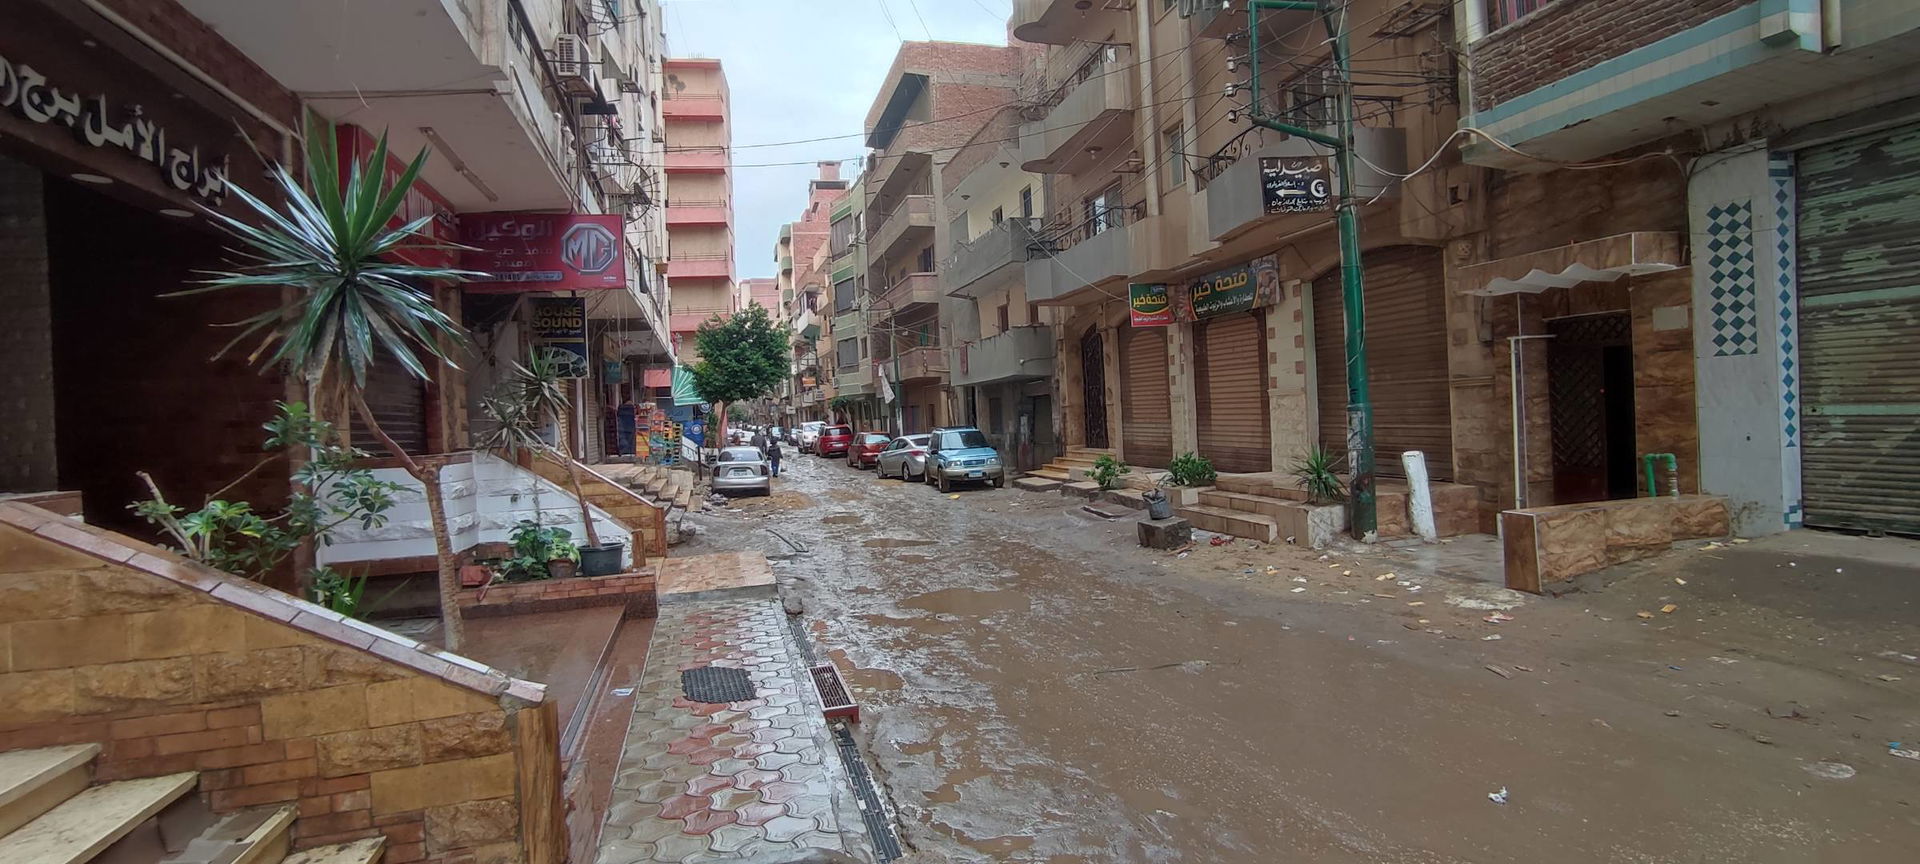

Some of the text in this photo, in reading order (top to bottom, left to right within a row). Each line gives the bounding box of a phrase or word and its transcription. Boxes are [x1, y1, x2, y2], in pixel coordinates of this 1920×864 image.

[18, 64, 81, 127] برج
[1262, 159, 1323, 178] صيدلية
[567, 229, 612, 270] MG
[1191, 268, 1248, 303] فتحة خير
[1133, 293, 1167, 307] فتحة خير
[532, 317, 583, 328] SOUND
